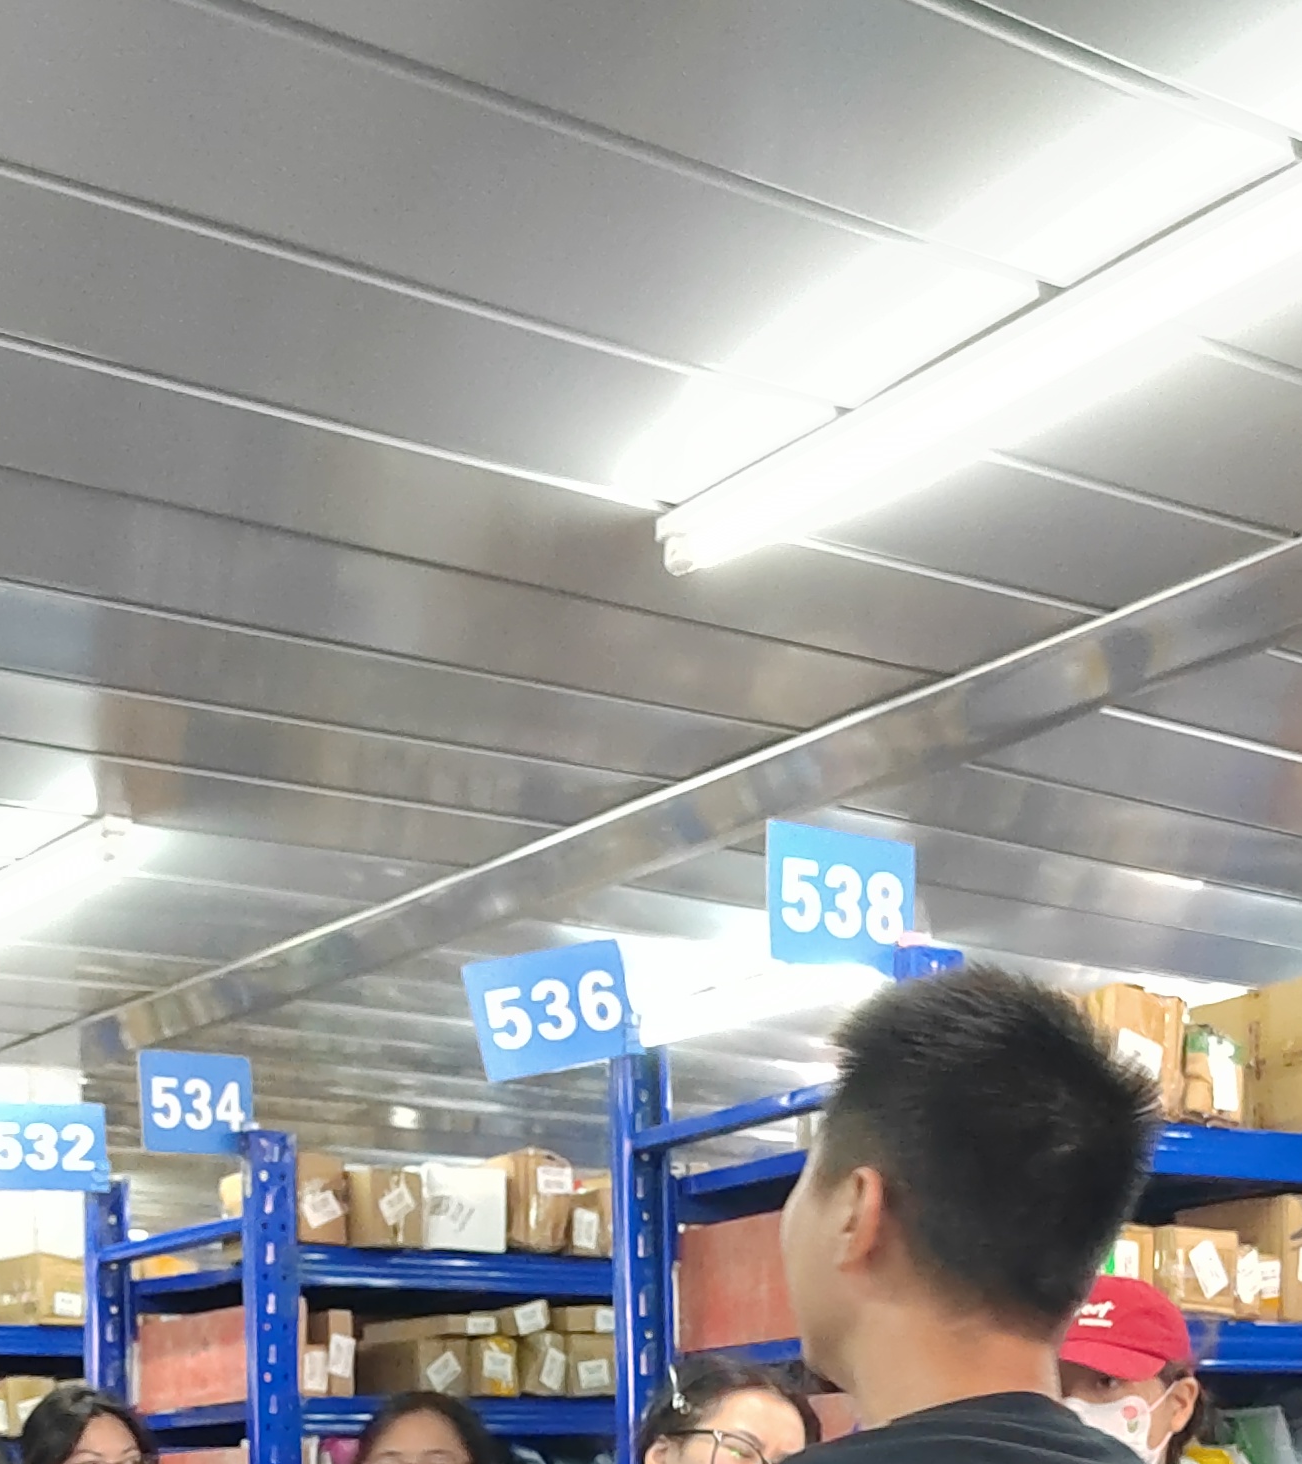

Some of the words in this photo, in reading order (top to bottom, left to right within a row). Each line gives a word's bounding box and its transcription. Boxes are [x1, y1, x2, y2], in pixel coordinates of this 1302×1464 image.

[779, 856, 905, 944] 538
[484, 969, 624, 1051] 536
[150, 1076, 246, 1132] 534
